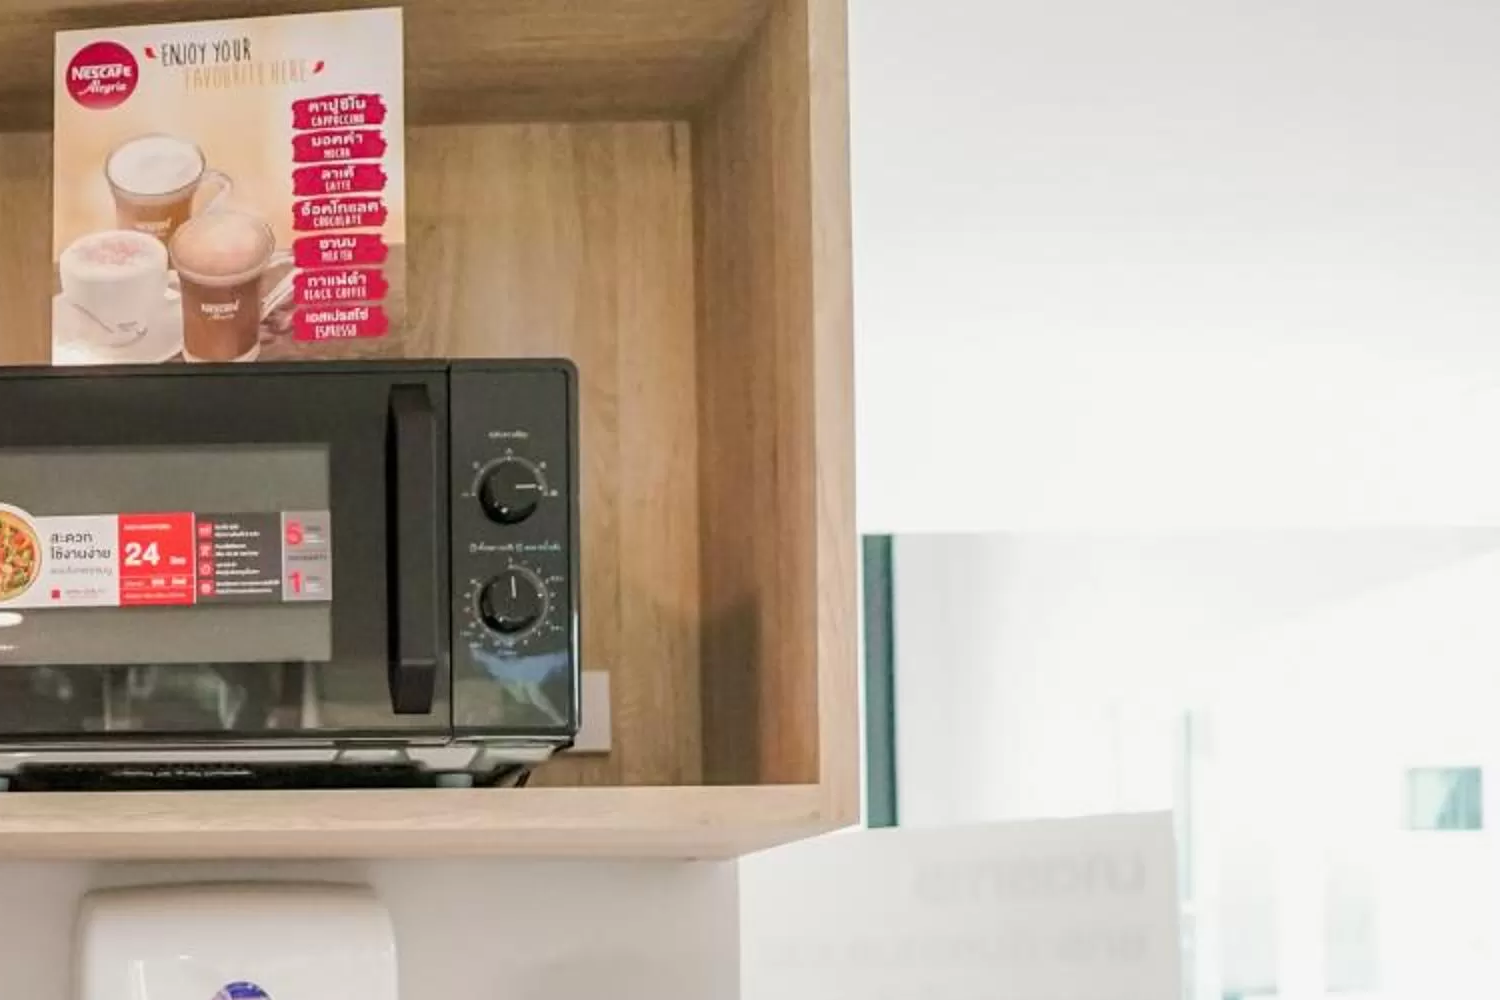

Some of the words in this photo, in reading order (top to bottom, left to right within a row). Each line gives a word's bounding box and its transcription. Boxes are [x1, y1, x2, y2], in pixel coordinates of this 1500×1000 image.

[161, 43, 206, 67] ENJOY
[212, 37, 251, 63] YOUR
[271, 60, 308, 83] HERE
[325, 180, 351, 192] LATTE
[304, 288, 332, 300] BLACK
[335, 286, 367, 299] COFFEE
[124, 542, 160, 566] 24
